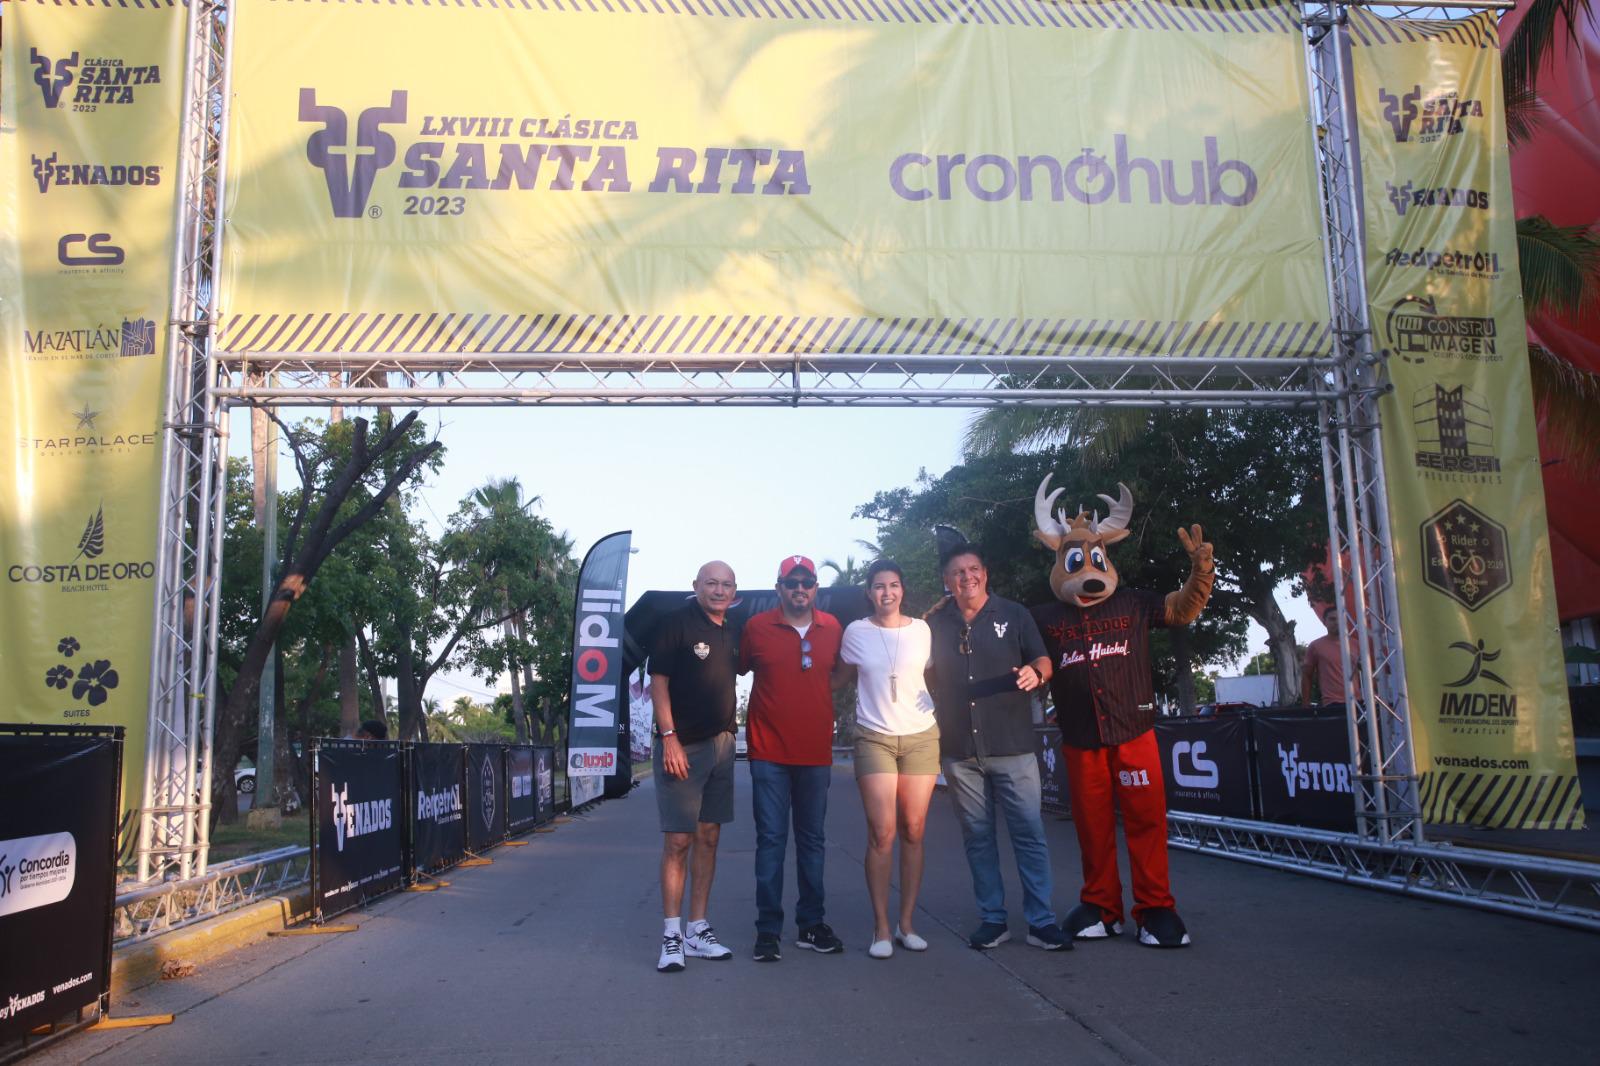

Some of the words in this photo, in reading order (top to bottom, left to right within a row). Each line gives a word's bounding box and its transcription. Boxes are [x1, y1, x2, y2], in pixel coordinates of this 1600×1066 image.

[84, 57, 123, 67] CLÁSICA
[79, 65, 160, 85] SANTA
[73, 85, 134, 104] RITA
[72, 104, 97, 112] 2023
[420, 116, 513, 137] LXVIII
[519, 113, 639, 140] CLÁSICA
[398, 142, 632, 193] SANTA
[648, 147, 812, 195] RITA
[889, 134, 1258, 207] cronohub
[403, 196, 466, 216] 2023
[58, 233, 125, 265] CS
[1427, 319, 1494, 336] CONSTRU
[24, 324, 119, 353] MAZATLÁN
[1451, 534, 1477, 546] Rider
[8, 566, 81, 582] COSTA
[85, 565, 110, 580] DE
[112, 562, 155, 579] ORO
[64, 709, 90, 718] SUITES
[1440, 692, 1517, 717] IMDEM
[1172, 740, 1218, 789] CS
[1434, 755, 1530, 770] venados.com
[1119, 769, 1150, 786] 911
[1298, 762, 1356, 793] STOR
[19, 850, 70, 874] Concordia
[53, 972, 93, 995] venados.com
